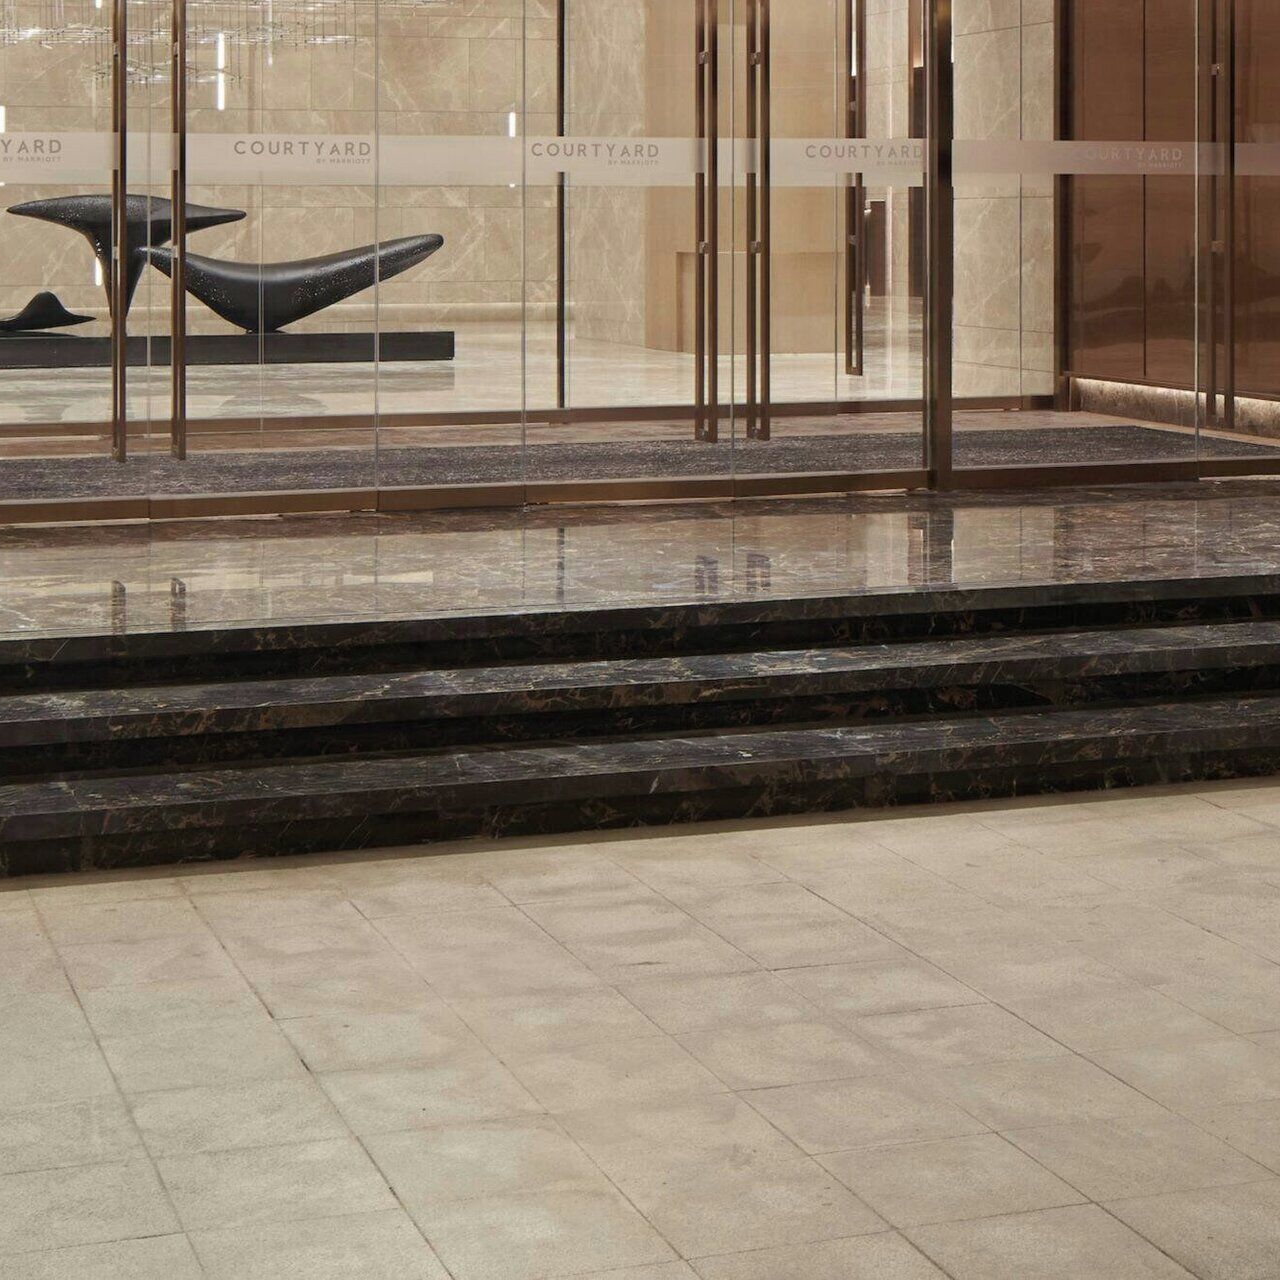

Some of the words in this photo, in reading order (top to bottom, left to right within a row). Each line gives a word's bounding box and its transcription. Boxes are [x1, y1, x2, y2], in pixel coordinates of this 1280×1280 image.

[233, 140, 372, 156] COURTYARD
[531, 142, 660, 158] COURTYARD
[805, 144, 923, 159] COURTYARD
[1072, 147, 1183, 161] OURTYARD
